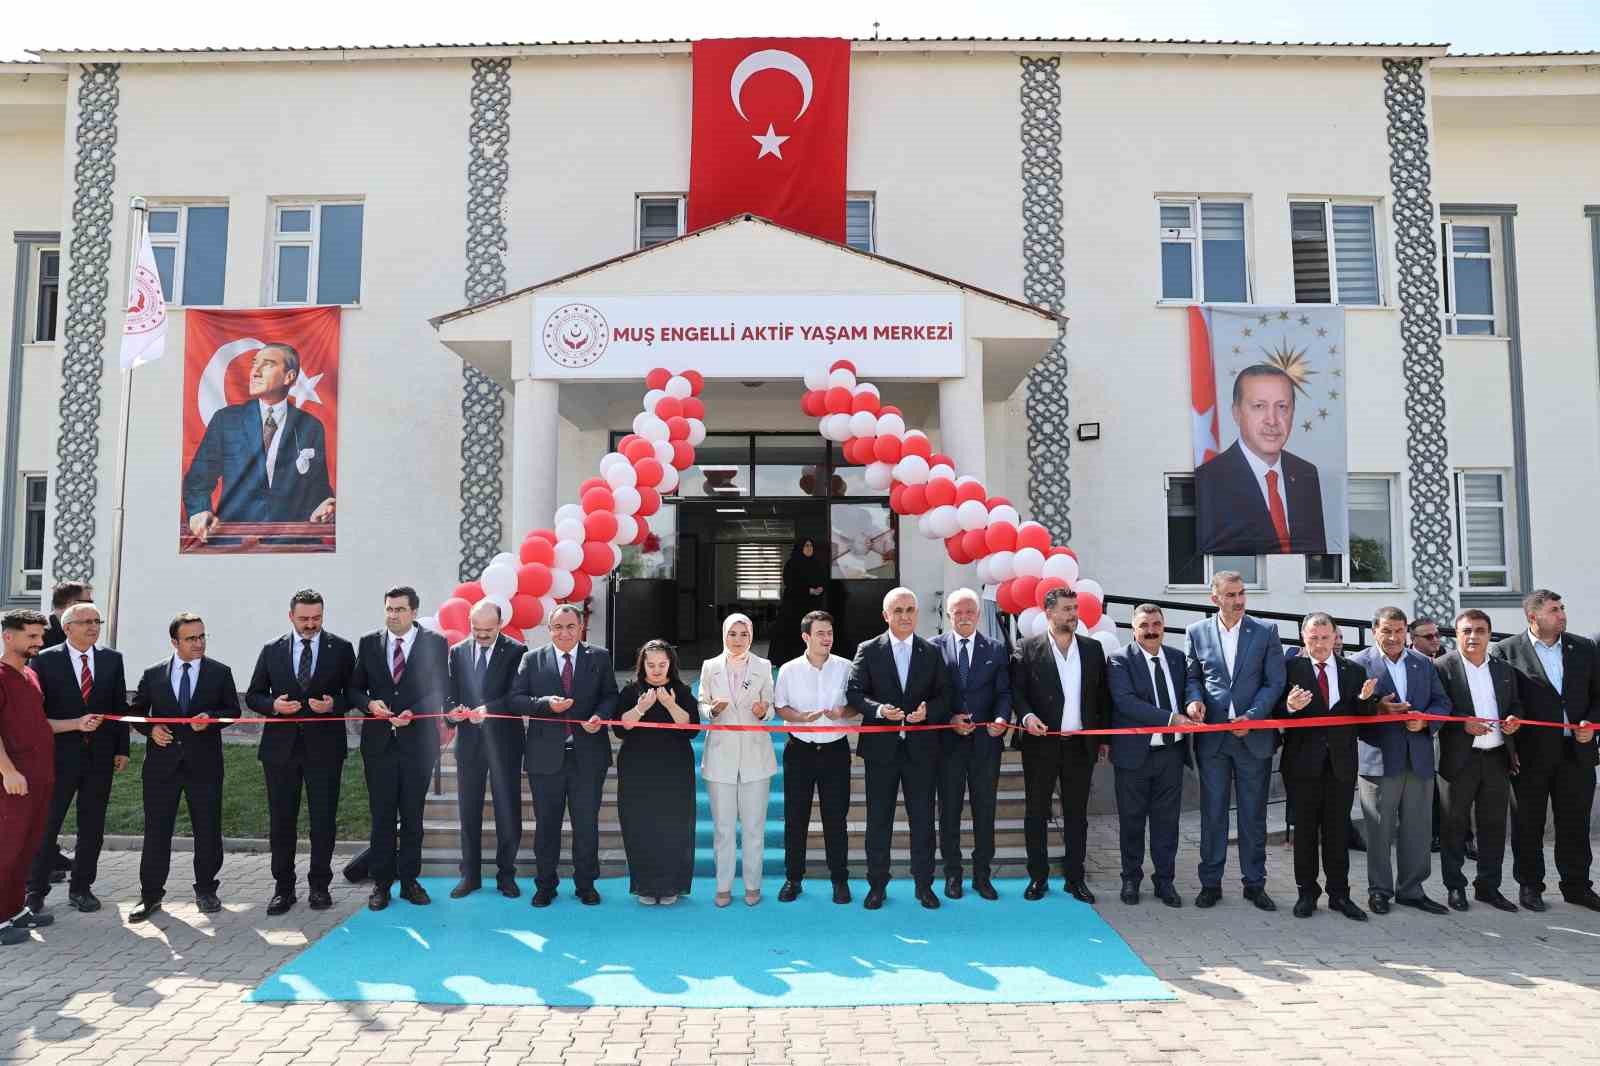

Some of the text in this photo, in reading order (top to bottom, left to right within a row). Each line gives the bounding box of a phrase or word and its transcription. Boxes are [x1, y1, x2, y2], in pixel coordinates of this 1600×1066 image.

[613, 327, 656, 347] MUŞ
[660, 322, 735, 342] ENGELLİ
[740, 322, 795, 341] AKTİF
[799, 325, 868, 346] YAŞAM
[873, 321, 953, 341] MERKEZİ
